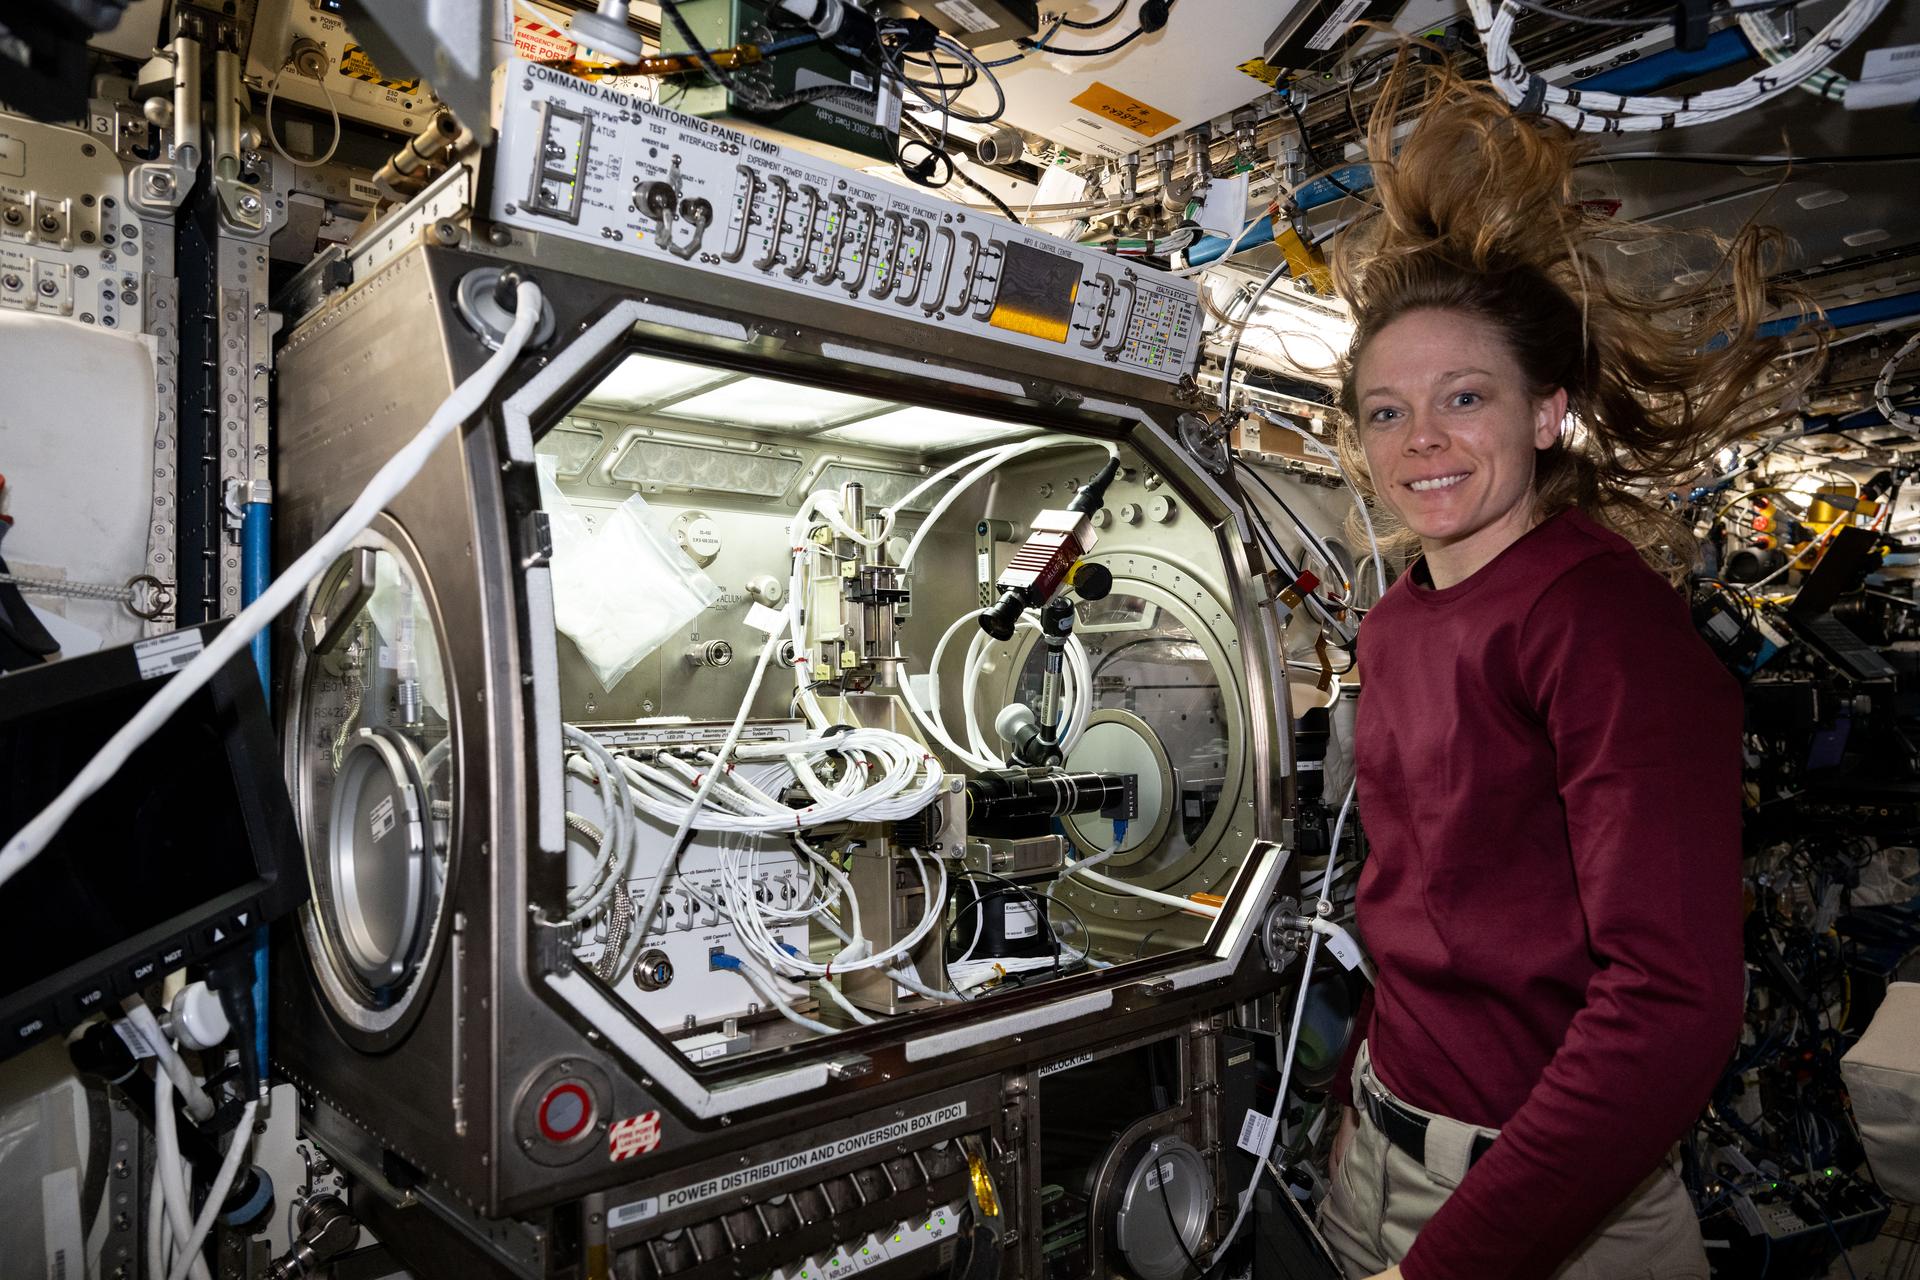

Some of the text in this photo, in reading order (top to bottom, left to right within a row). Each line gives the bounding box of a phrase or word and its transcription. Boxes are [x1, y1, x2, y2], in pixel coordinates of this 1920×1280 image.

[320, 16, 342, 27] POWER
[322, 23, 334, 31] OUT
[516, 31, 568, 52] EMERGENCY USE
[514, 39, 567, 61] FIRE PORT
[526, 64, 780, 157] COMMAND AND MONITORING PANEL (CMP)
[549, 96, 566, 109] PWR
[1127, 104, 1150, 116] #2
[602, 112, 619, 124] PWR
[816, 108, 834, 125] Supply
[835, 116, 851, 130] Power
[1102, 104, 1148, 128] ICEBERG
[96, 117, 109, 133] 3
[591, 123, 616, 138] TATUS
[649, 123, 718, 152] TEST INTERFACES
[747, 154, 829, 187] EXPERIMENT POWER OUTLETS
[892, 200, 911, 213] SPECIAL
[912, 206, 938, 220] FUNCTIONS
[1024, 236, 1034, 246] INFO
[1039, 242, 1056, 254] CONTROL
[1058, 247, 1072, 258] CENTRE
[164, 949, 183, 964] NGT
[1336, 950, 1344, 958] P2
[135, 964, 153, 978] DAY
[668, 1105, 962, 1207] POWER DISTRIBUTION AND CONVERSION BOX (PDC)
